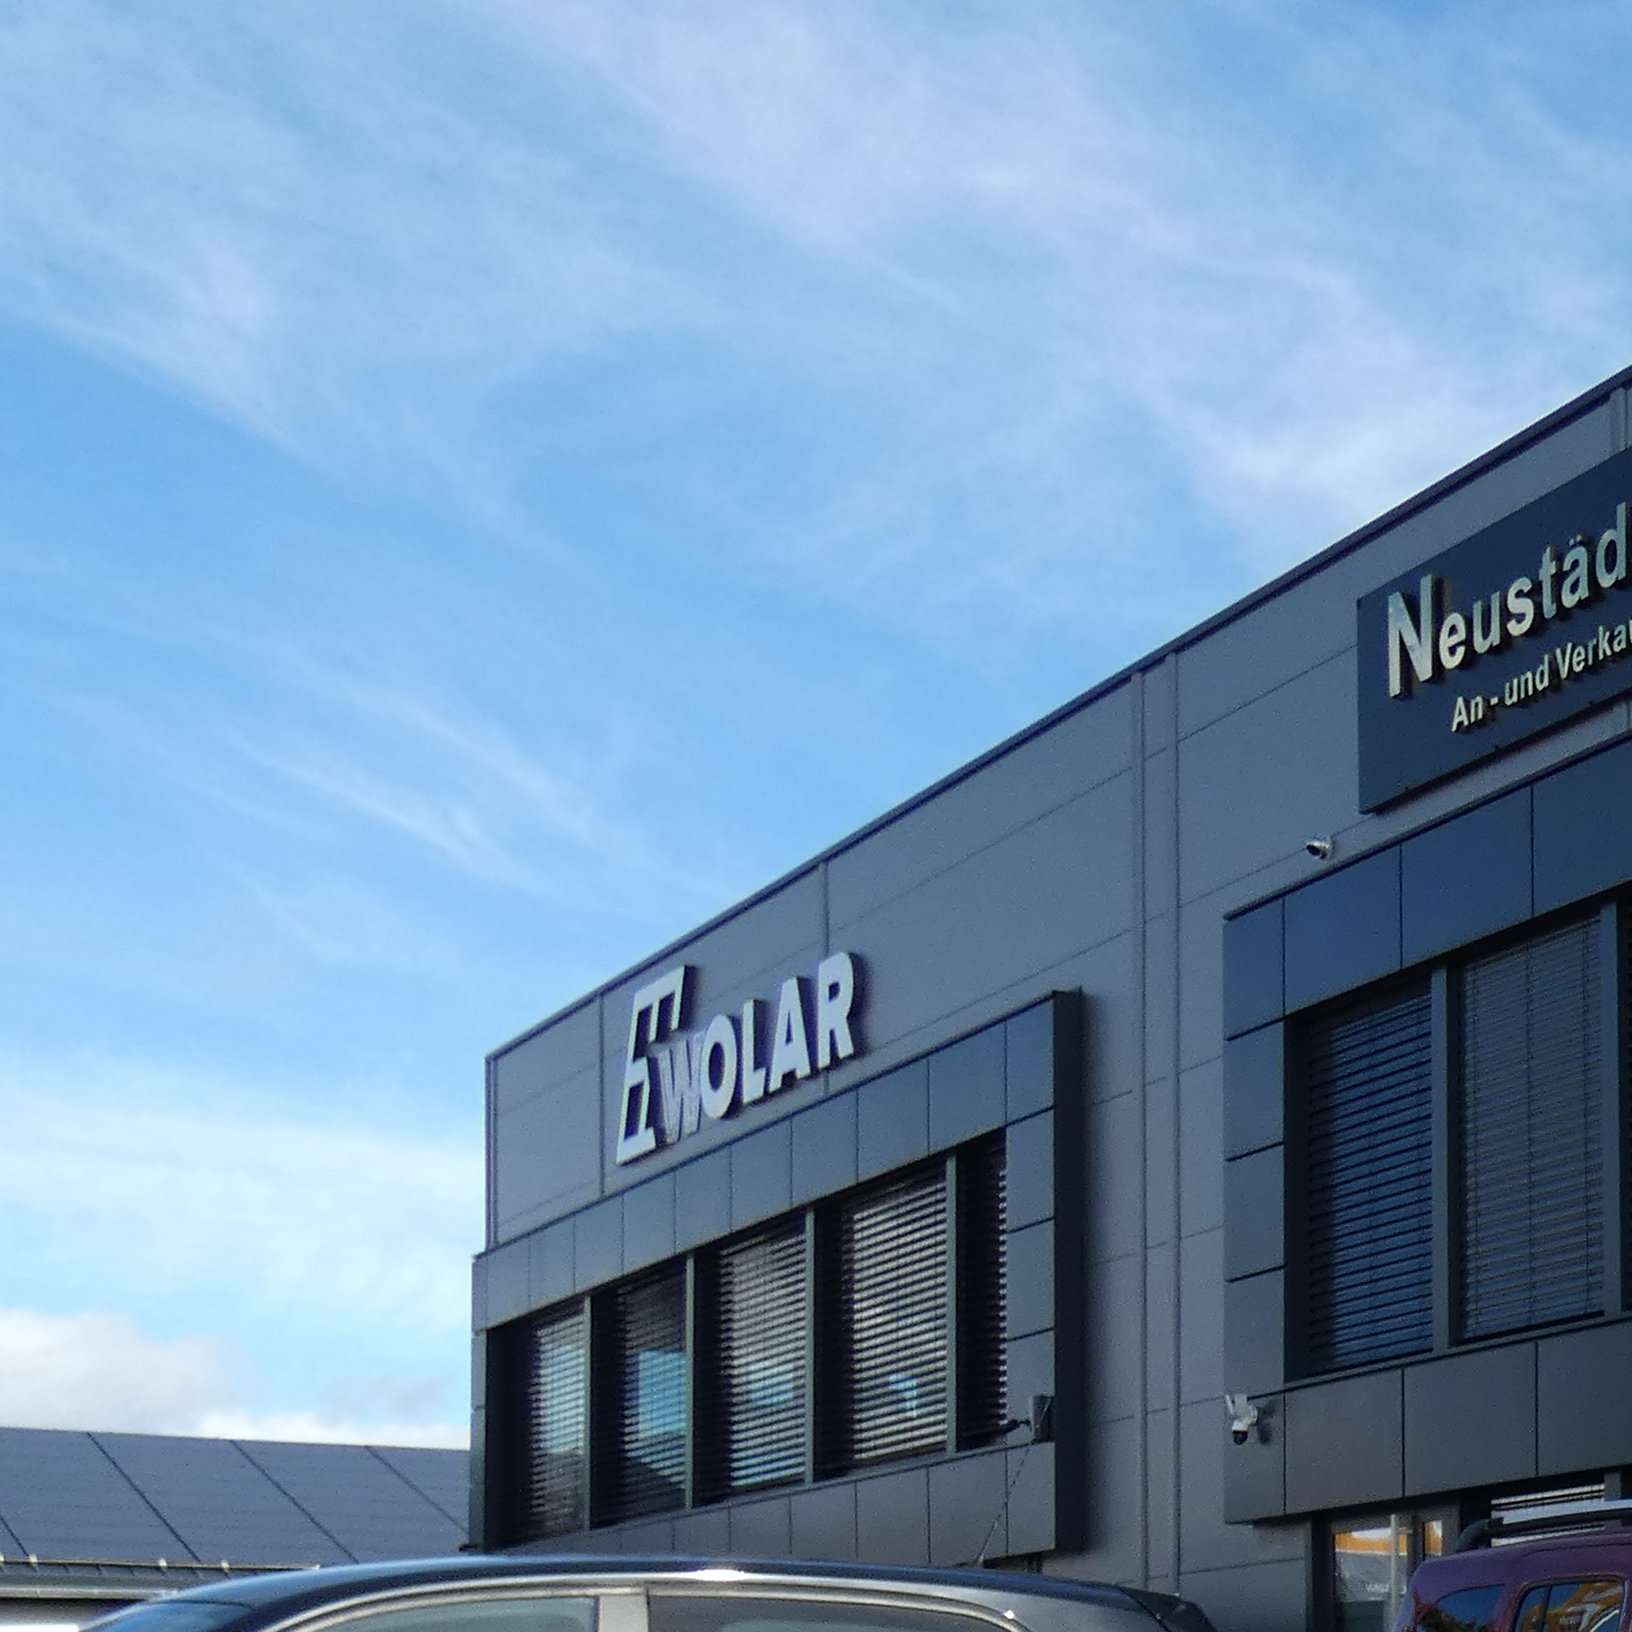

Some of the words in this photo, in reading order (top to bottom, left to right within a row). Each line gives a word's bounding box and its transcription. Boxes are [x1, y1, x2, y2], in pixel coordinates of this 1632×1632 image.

[1452, 695, 1483, 732] An
[1504, 654, 1550, 706] und
[655, 952, 855, 1144] WOLAR
